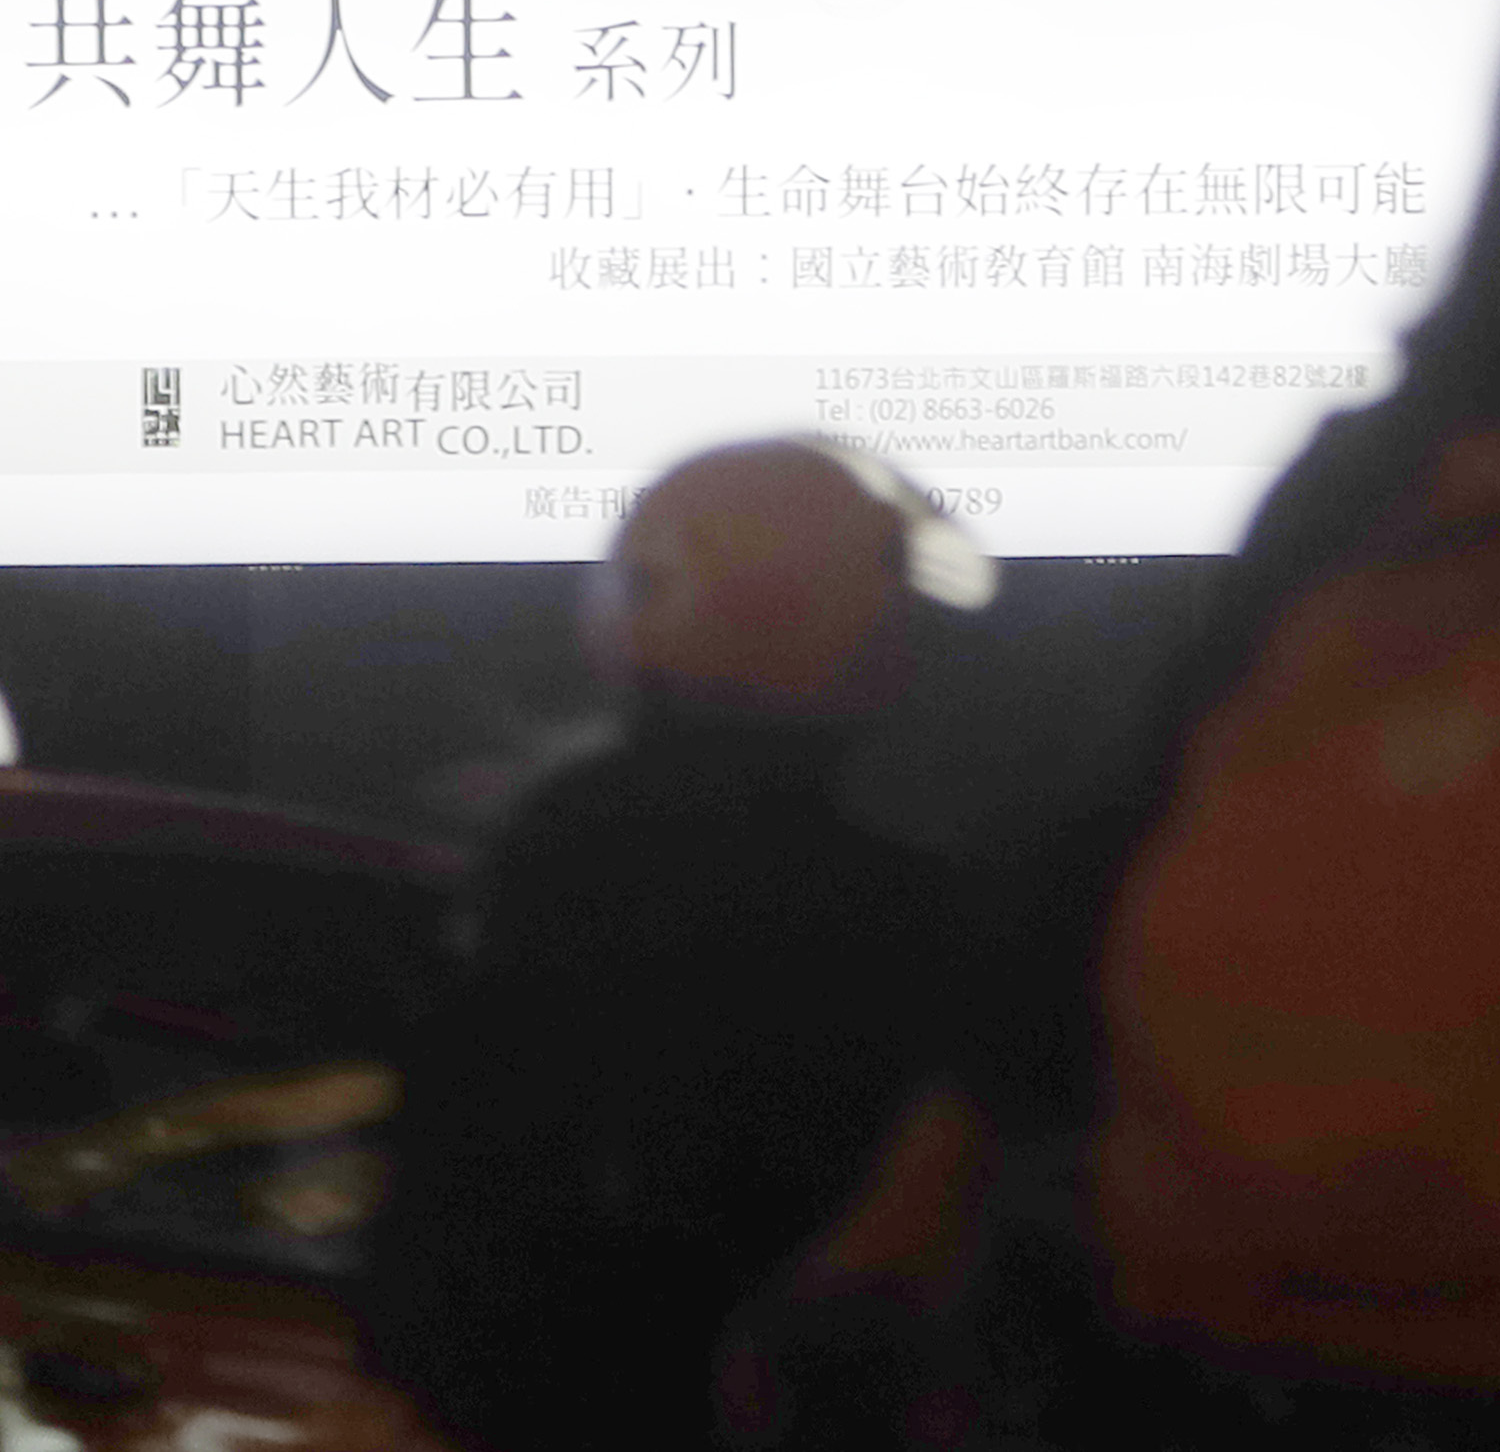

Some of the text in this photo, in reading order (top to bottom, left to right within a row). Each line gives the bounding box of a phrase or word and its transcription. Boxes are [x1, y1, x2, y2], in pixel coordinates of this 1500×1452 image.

[573, 18, 740, 103] 系列
[219, 362, 584, 413] 心然藝術有限公司
[869, 397, 917, 425] (02)
[923, 397, 1056, 422] 8663-6026
[219, 417, 594, 459] HEART ART CO.,LTD.
